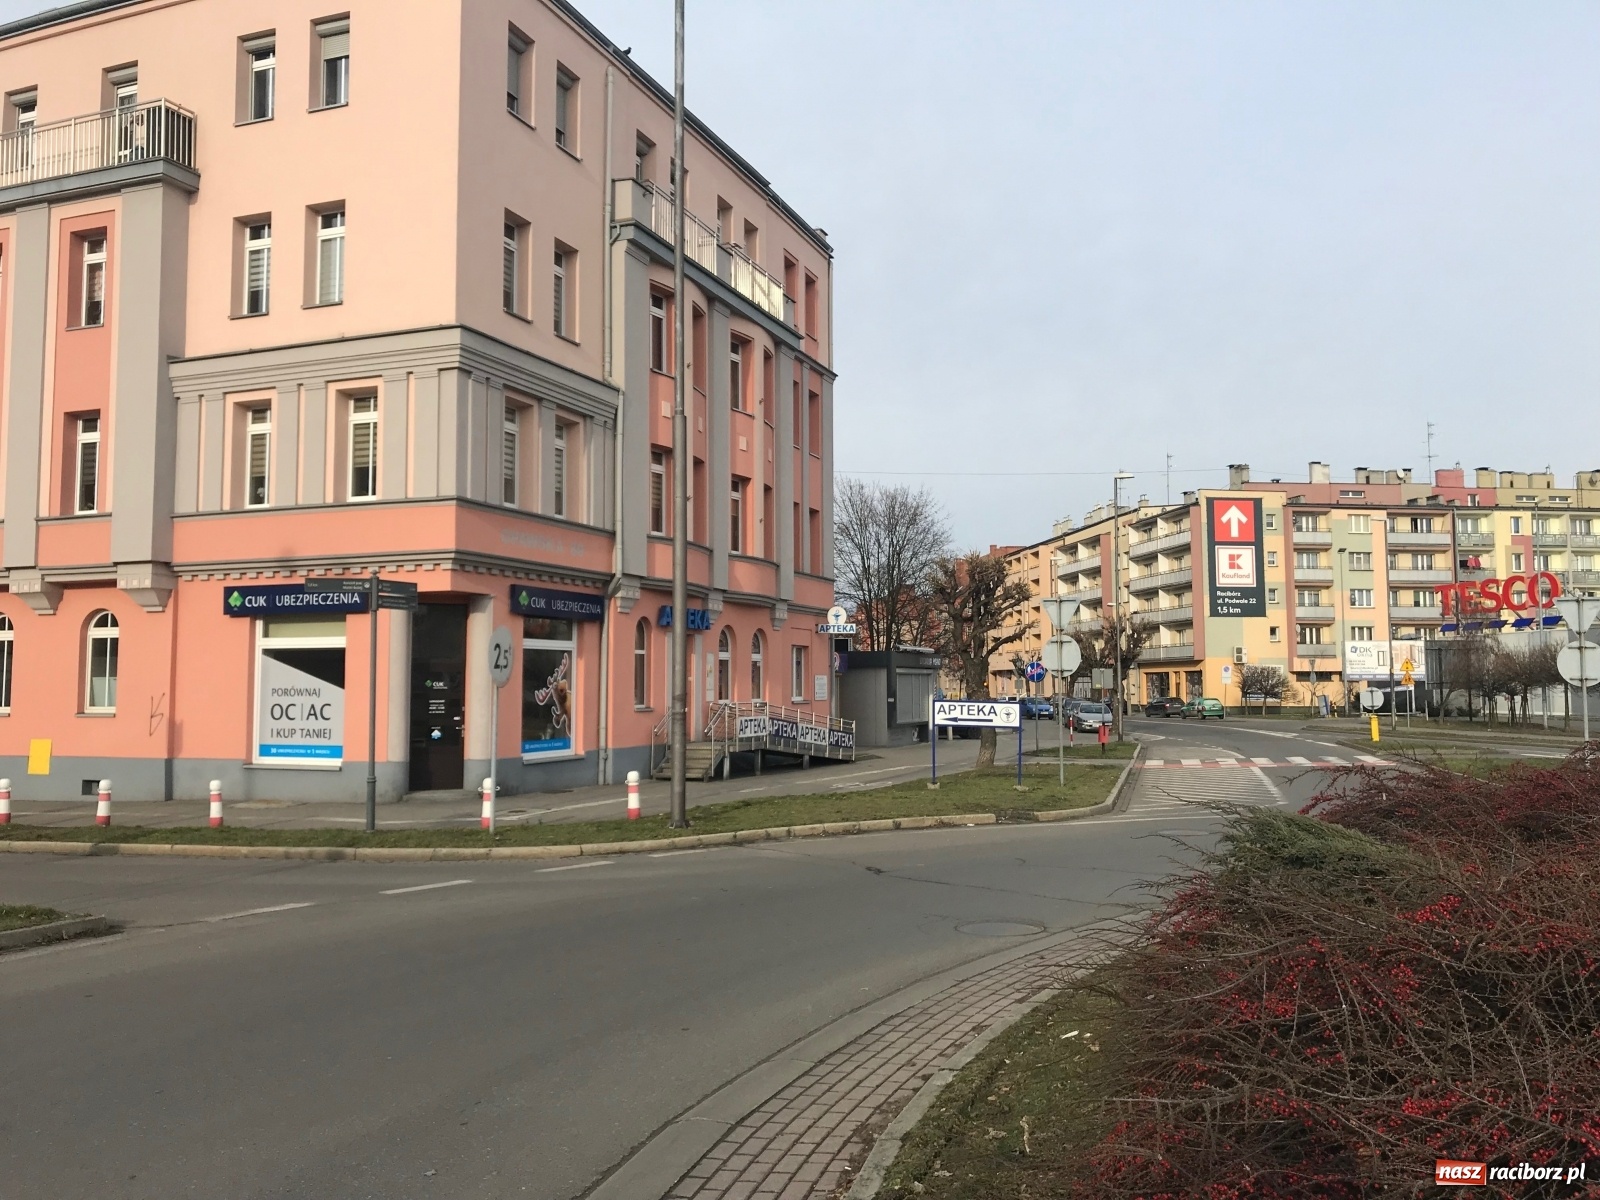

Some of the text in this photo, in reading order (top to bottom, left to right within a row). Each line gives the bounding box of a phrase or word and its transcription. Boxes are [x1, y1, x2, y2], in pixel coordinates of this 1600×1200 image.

[245, 592, 361, 607] CUK UBEZPIECZENIA
[1434, 571, 1560, 616] TESCO
[530, 596, 601, 614] CUK UBEZPIECZENIA
[1217, 606, 1242, 614] 1,5 km
[819, 624, 855, 633] APTEKA
[1358, 646, 1372, 654] DK
[271, 686, 321, 699] PORÓWNAJ
[270, 703, 332, 721] OC AC
[936, 703, 998, 717] APTEKA
[739, 716, 767, 736] APTEKA
[768, 718, 797, 739] APTEKA
[800, 723, 827, 743] APTEKA
[270, 728, 332, 741] I KUP TANIEJ
[829, 731, 854, 747] APTEKA
